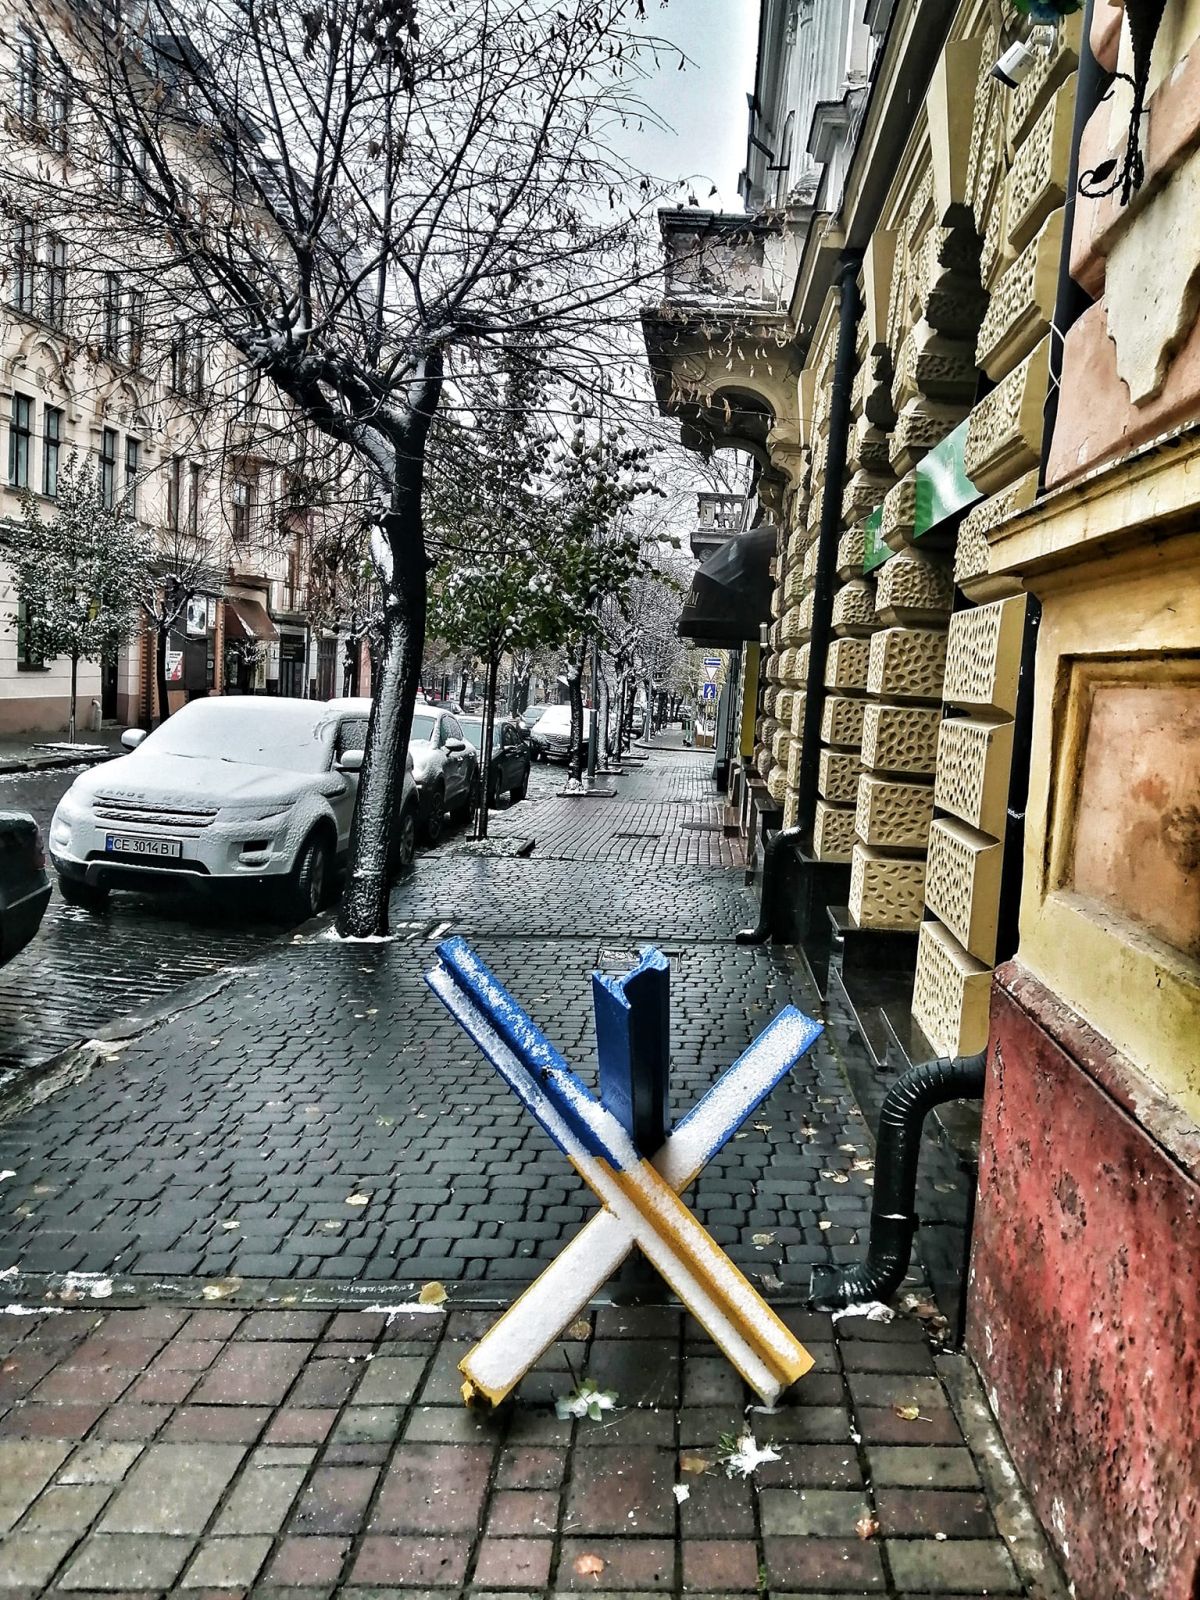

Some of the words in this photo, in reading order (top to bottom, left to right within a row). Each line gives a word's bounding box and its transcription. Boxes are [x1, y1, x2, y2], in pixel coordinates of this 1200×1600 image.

[114, 838, 130, 851] CE
[133, 841, 158, 854] 3014
[161, 843, 175, 855] BI
